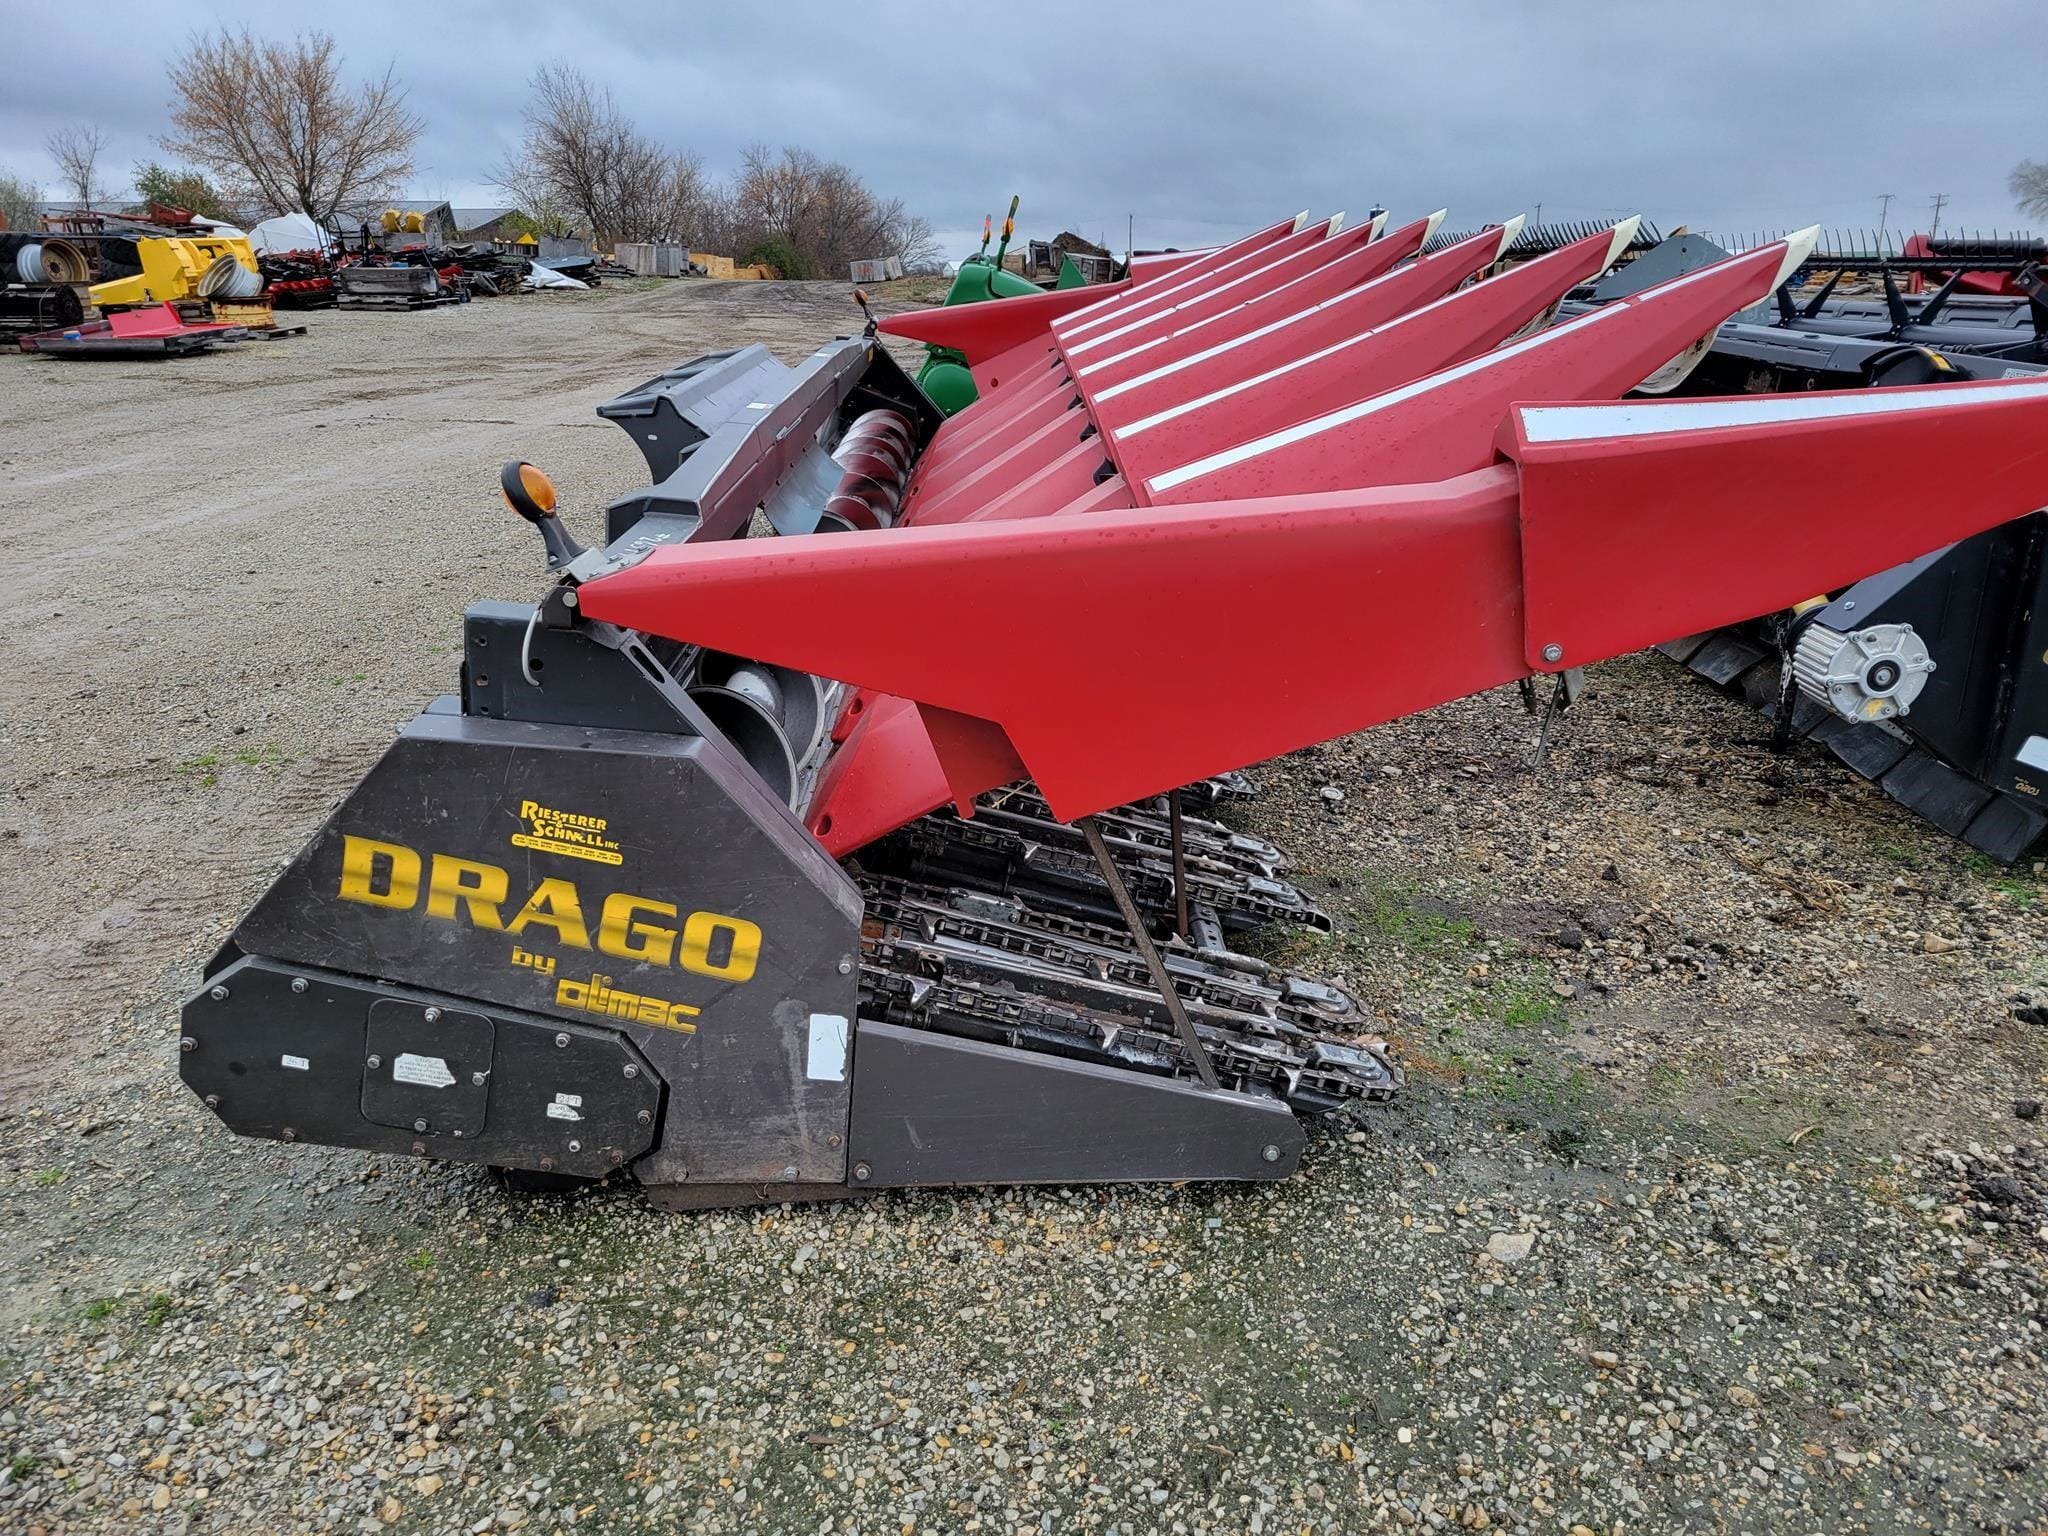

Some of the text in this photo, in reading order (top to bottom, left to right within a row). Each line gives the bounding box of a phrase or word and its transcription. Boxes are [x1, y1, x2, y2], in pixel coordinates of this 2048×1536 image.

[520, 799, 607, 831] RIESTERER
[532, 818, 604, 847] SCHNELL
[604, 840, 620, 850] INC
[337, 834, 763, 984] DRAGO
[511, 945, 557, 977] by
[556, 973, 702, 1035] olimac
